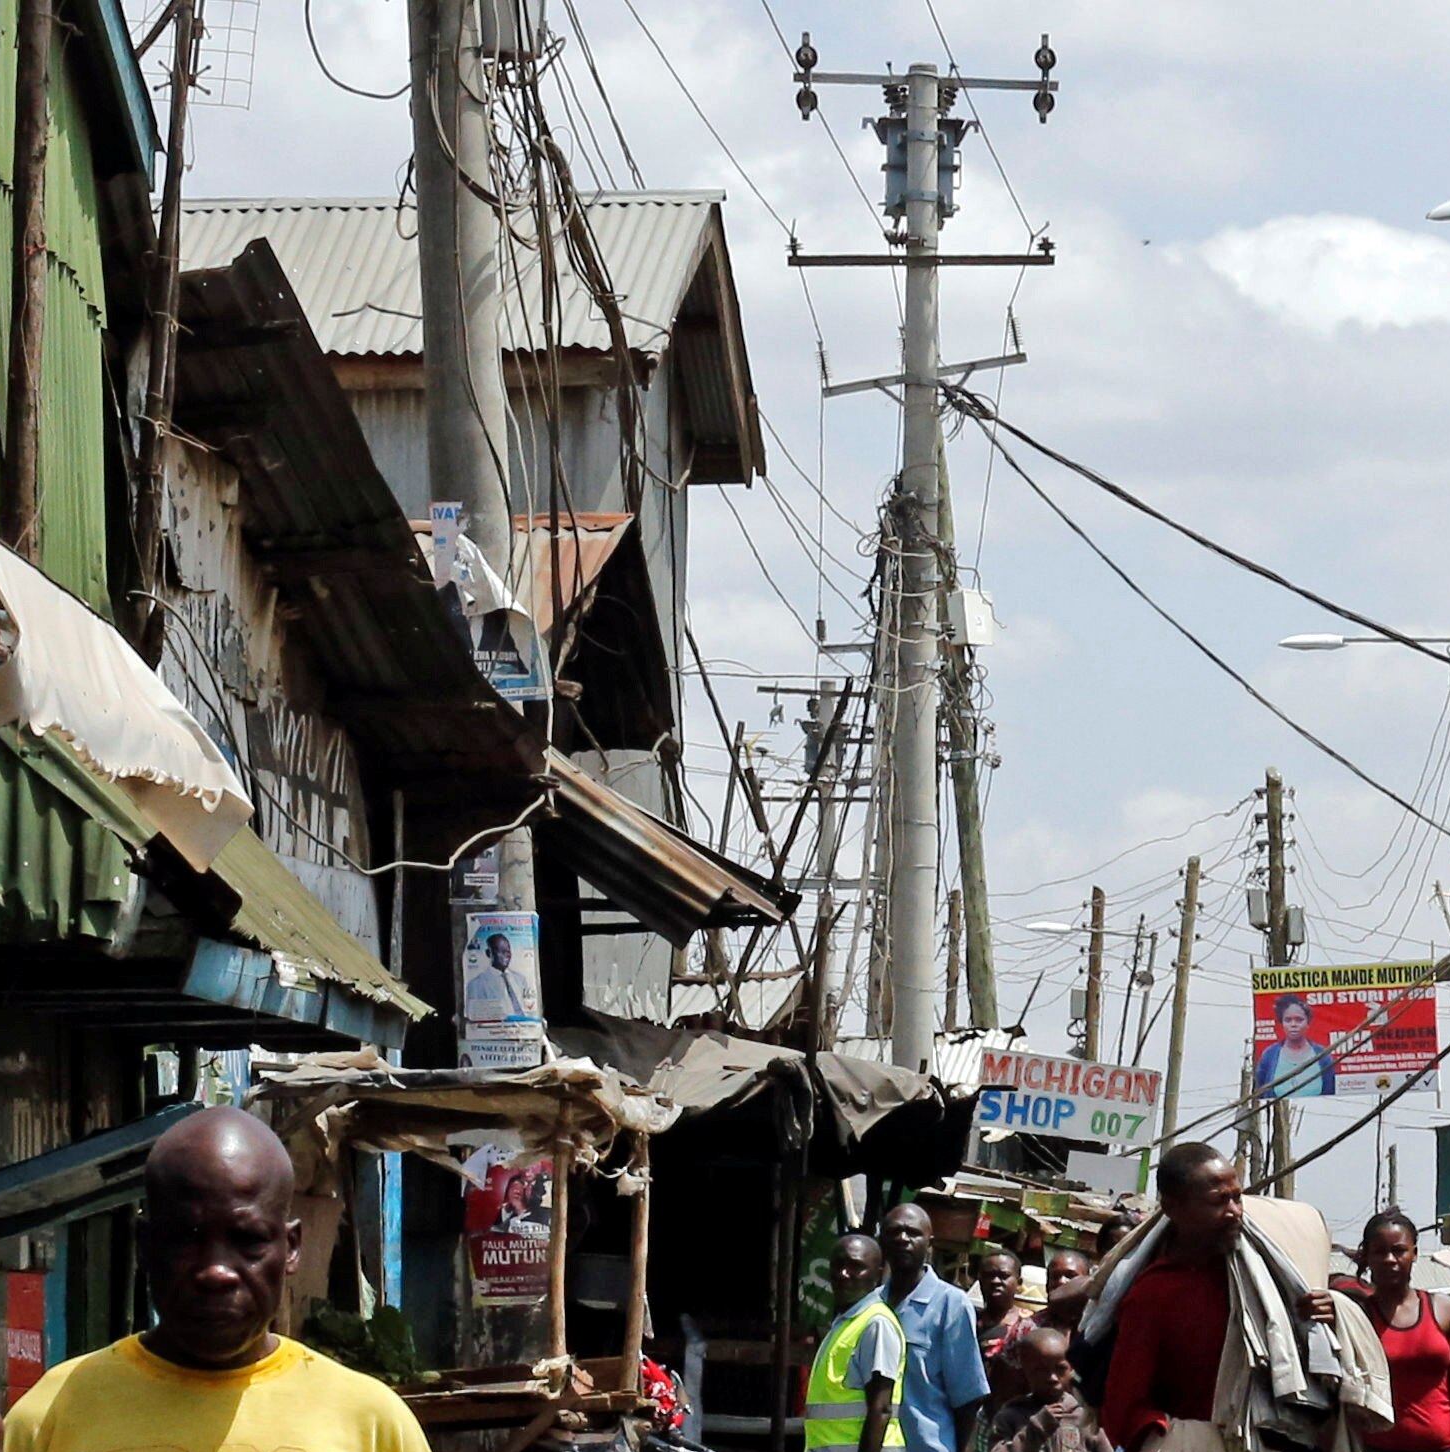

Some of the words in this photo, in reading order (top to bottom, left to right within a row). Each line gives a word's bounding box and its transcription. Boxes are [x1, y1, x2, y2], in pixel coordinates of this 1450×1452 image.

[1252, 971, 1329, 991] SCOLASTICA
[1331, 969, 1375, 987] MANDE
[1306, 991, 1334, 1006] SIO
[1337, 989, 1385, 1003] STORI
[982, 1053, 1160, 1105] MICHIGAN
[979, 1090, 1076, 1130] SHOP
[1090, 1110, 1147, 1139] 007
[482, 1239, 507, 1251] PAUL
